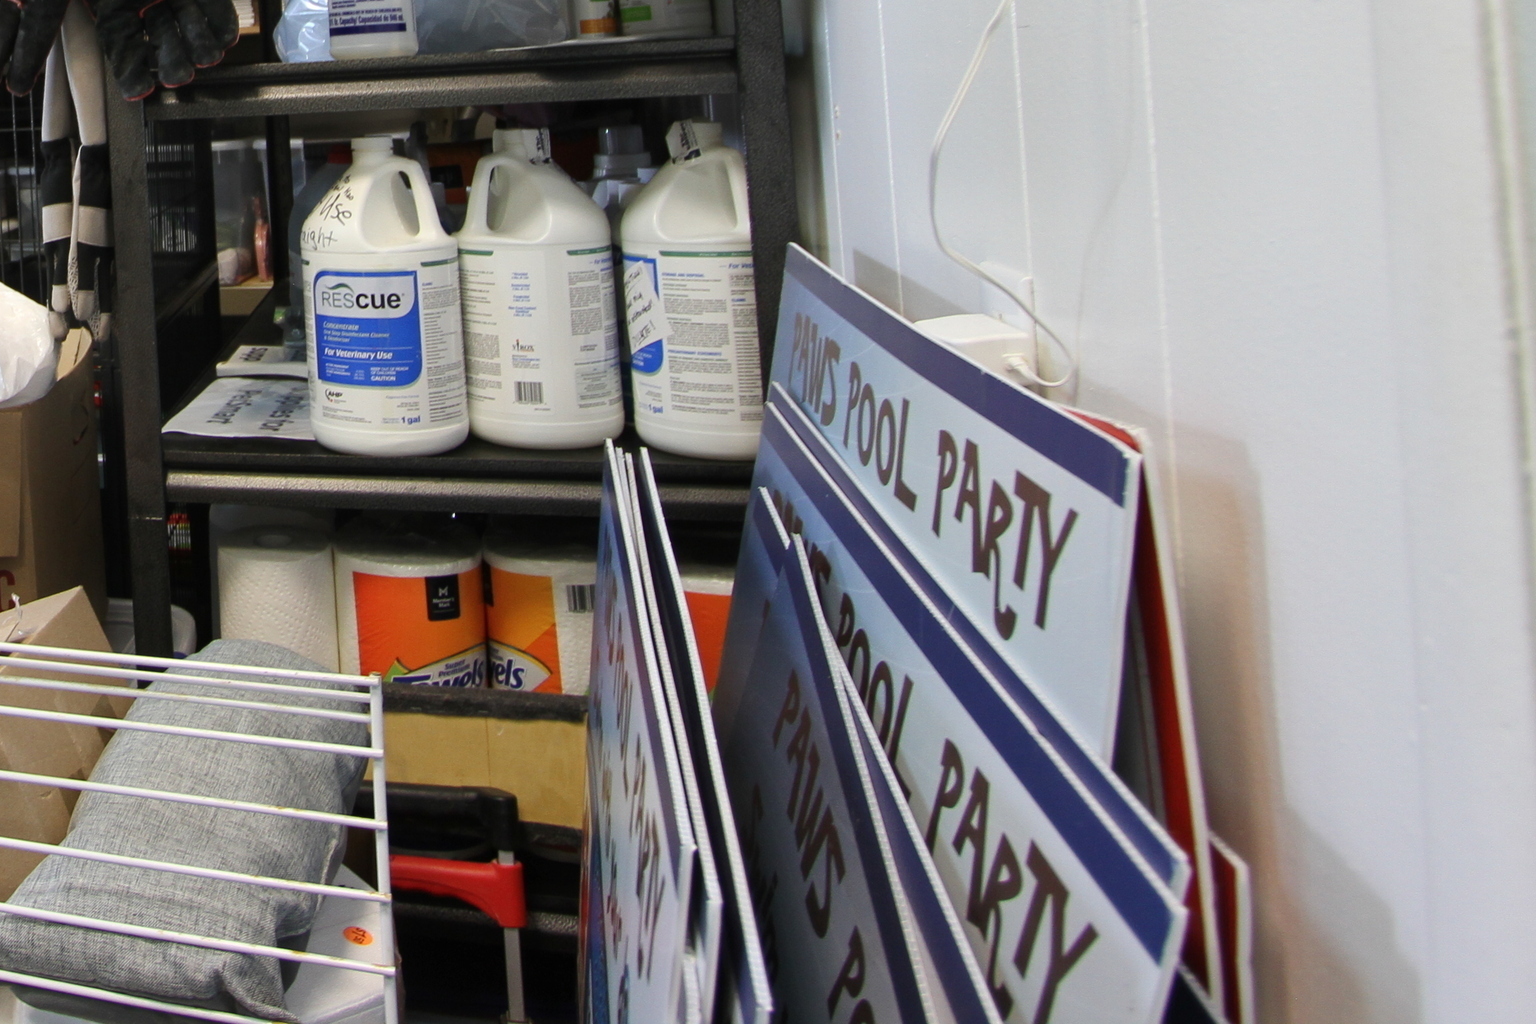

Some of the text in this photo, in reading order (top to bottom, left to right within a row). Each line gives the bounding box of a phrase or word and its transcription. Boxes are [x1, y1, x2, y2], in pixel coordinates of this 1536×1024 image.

[324, 347, 393, 361] For Veterinary Use
[406, 415, 421, 425] gal
[788, 312, 841, 427] PAWS
[843, 361, 918, 513] POOL
[932, 428, 1079, 641] PARTY
[392, 658, 484, 688] Tels
[444, 660, 466, 671] Super
[772, 668, 847, 940] PAWS
[926, 737, 1100, 1024] PARTY
